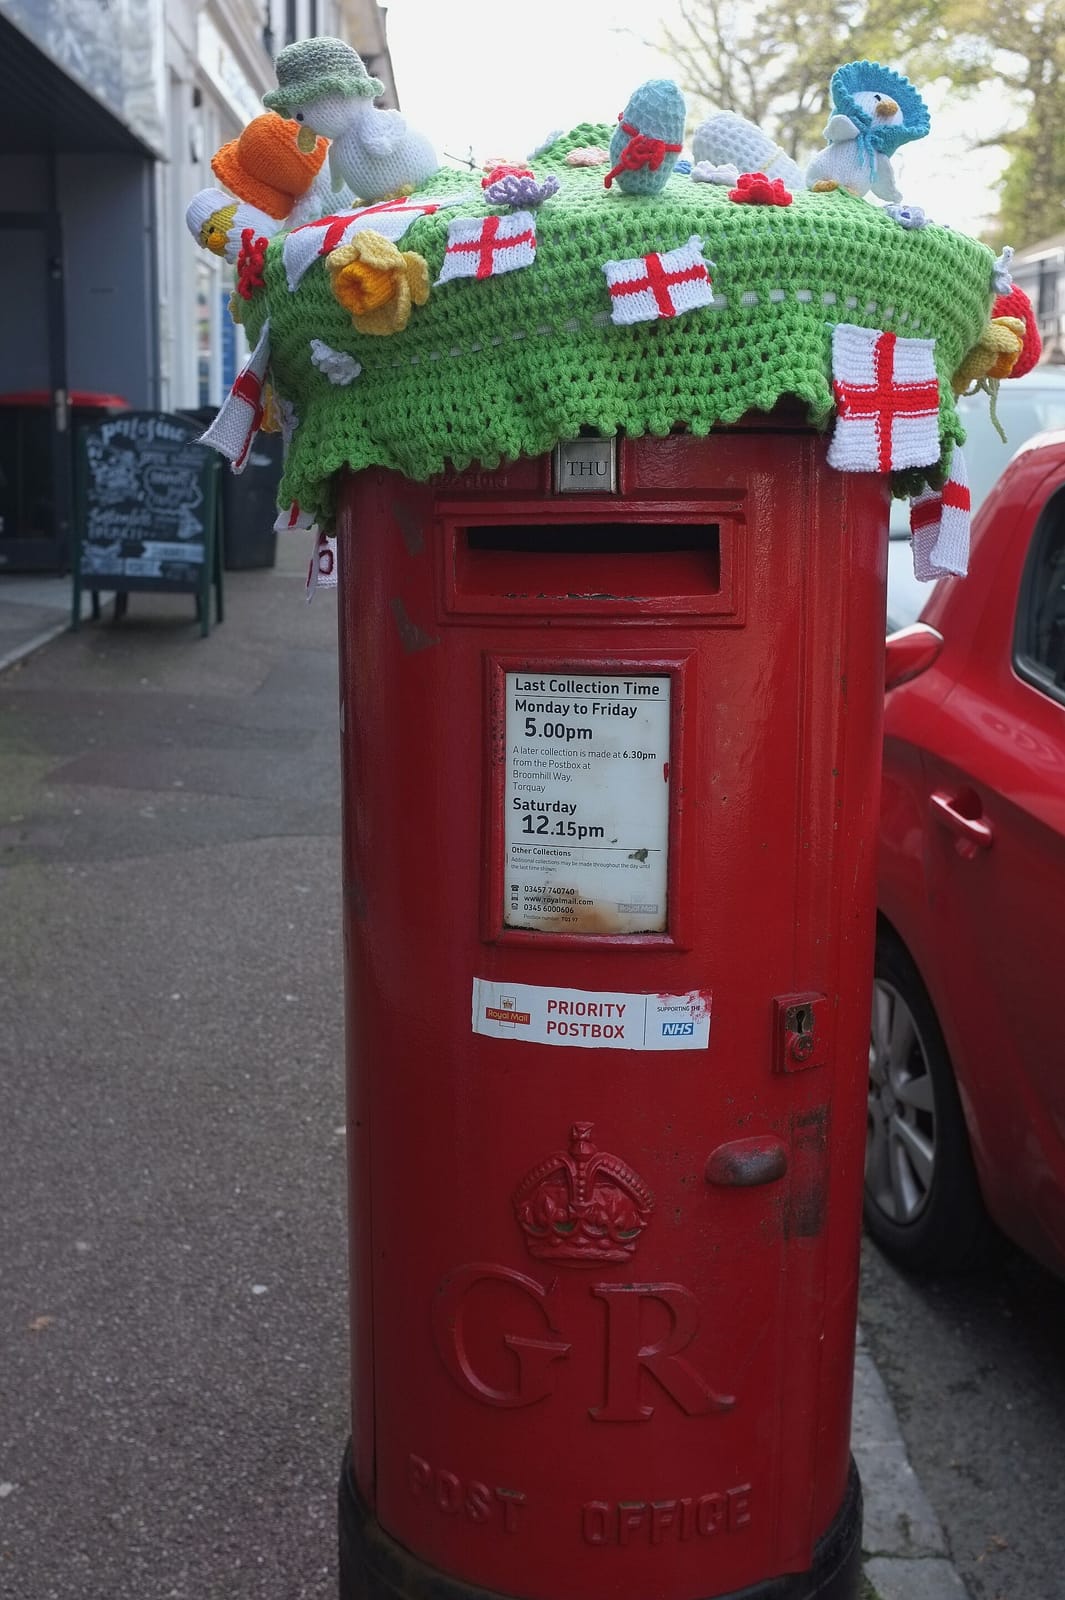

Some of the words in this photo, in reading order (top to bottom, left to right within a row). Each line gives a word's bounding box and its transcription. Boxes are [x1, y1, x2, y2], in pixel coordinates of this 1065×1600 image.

[567, 461, 608, 476] THU
[515, 678, 545, 691] Last
[550, 680, 619, 694] Collection
[624, 682, 659, 695] Time
[515, 699, 570, 716] Monday
[574, 704, 587, 714] to
[592, 703, 637, 718] Friday
[524, 718, 593, 742] 5.00pm
[513, 746, 519, 754] A
[520, 747, 538, 755] later
[540, 749, 578, 757] collection
[588, 750, 610, 758] made
[623, 751, 656, 760] 6.30pm
[548, 760, 581, 769] Postbox
[513, 770, 551, 780] Broomhill
[553, 773, 573, 782] Way,
[513, 782, 545, 793] Torquay
[513, 798, 577, 815] Saturday
[522, 814, 604, 839] 12.15pm
[512, 847, 532, 855] Other
[533, 848, 571, 856] Collections
[524, 886, 546, 894] 03457
[523, 896, 594, 906] www.royalmail.com
[487, 1009, 509, 1021] Royal
[510, 1013, 528, 1022] Mail
[547, 999, 626, 1018] PRIORITY
[547, 1020, 625, 1039] POSTBOX
[664, 1024, 692, 1034] NHS
[431, 1261, 738, 1424] GR
[406, 1452, 529, 1535] POST
[581, 1480, 754, 1548] OFFICE
